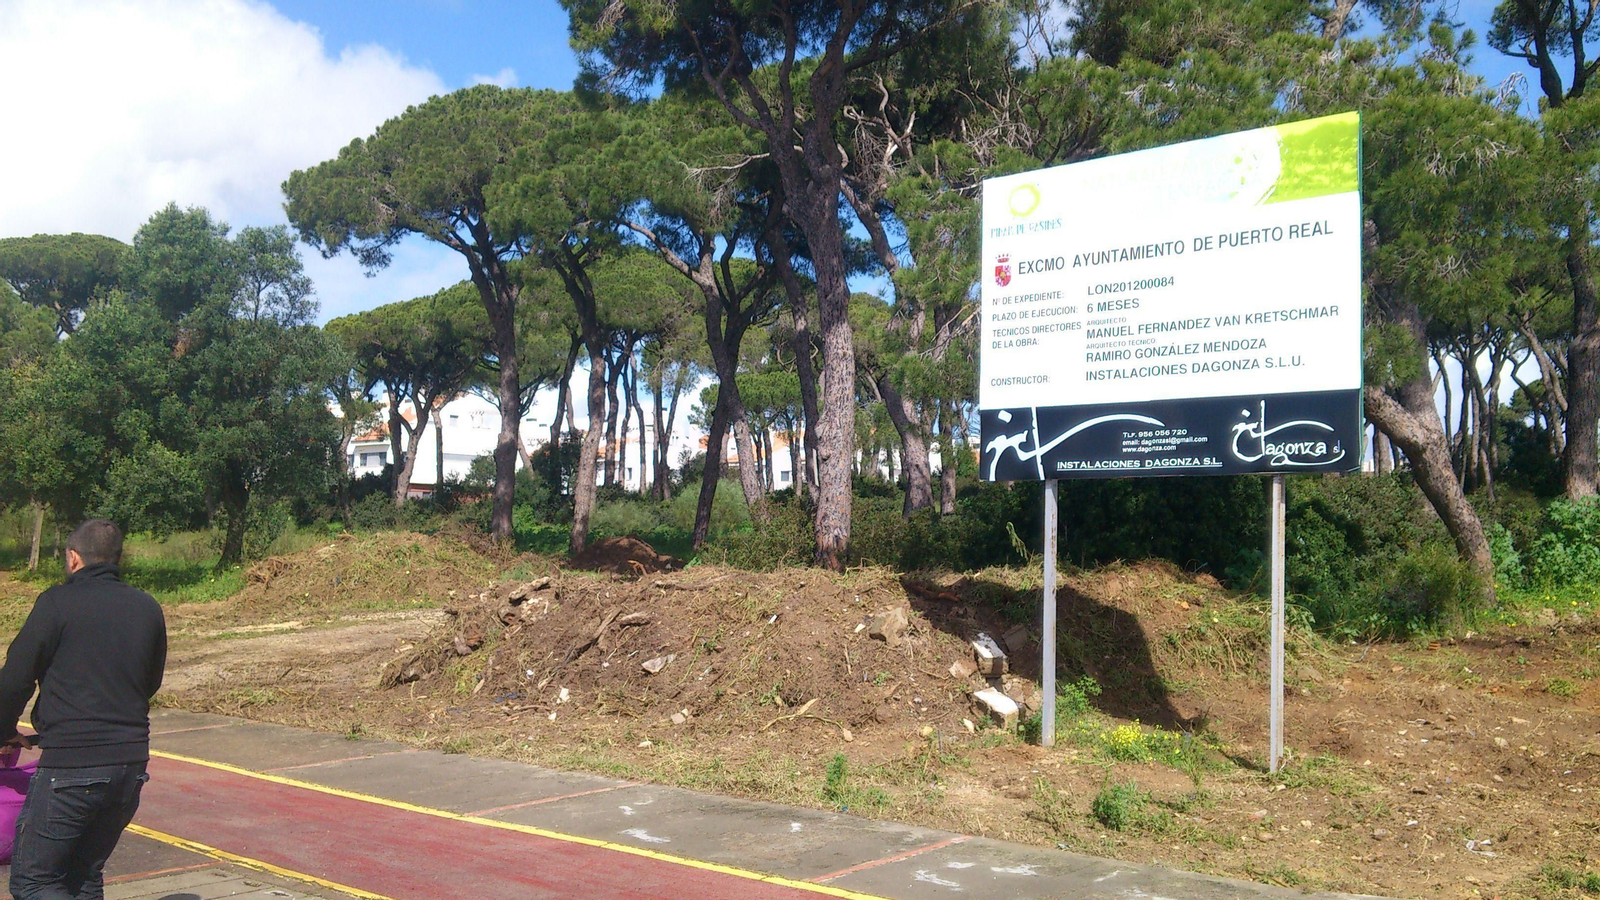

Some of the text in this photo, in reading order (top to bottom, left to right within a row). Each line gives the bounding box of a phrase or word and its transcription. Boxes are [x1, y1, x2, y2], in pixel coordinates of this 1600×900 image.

[1018, 220, 1334, 275] EXCMO AYUNTAMIENTO DE PUERTO REAL
[1087, 276, 1175, 296] LON201200084
[1002, 296, 1013, 305] DE
[1014, 290, 1065, 304] EXPEDIENTE:
[1086, 297, 1140, 313] 6 MESES
[992, 311, 1017, 322] PLAZO
[1019, 310, 1029, 319] DE
[1086, 316, 1127, 326] ARQUITECTO
[1086, 305, 1339, 340] MANUEL FERNANDEZ VAN KRETSCHMAR
[992, 321, 1082, 338] TECNICOS DIRECTORES
[992, 338, 1040, 349] DE LA OBRA:
[1085, 340, 1126, 350] ARQUITECTO
[1086, 338, 1268, 363] RAMIRO GONZÁLEZ MENDOZA
[1085, 355, 1305, 381] INSTALACIONES DAGONZA S.L.U.
[990, 374, 1051, 387] CONSTRUCTOR:
[1154, 429, 1170, 437] 056
[1171, 428, 1188, 436] 720
[1122, 444, 1177, 453] www.dagonza.com
[1057, 456, 1223, 469] INSTALACIONES DAGONZA S.L.
